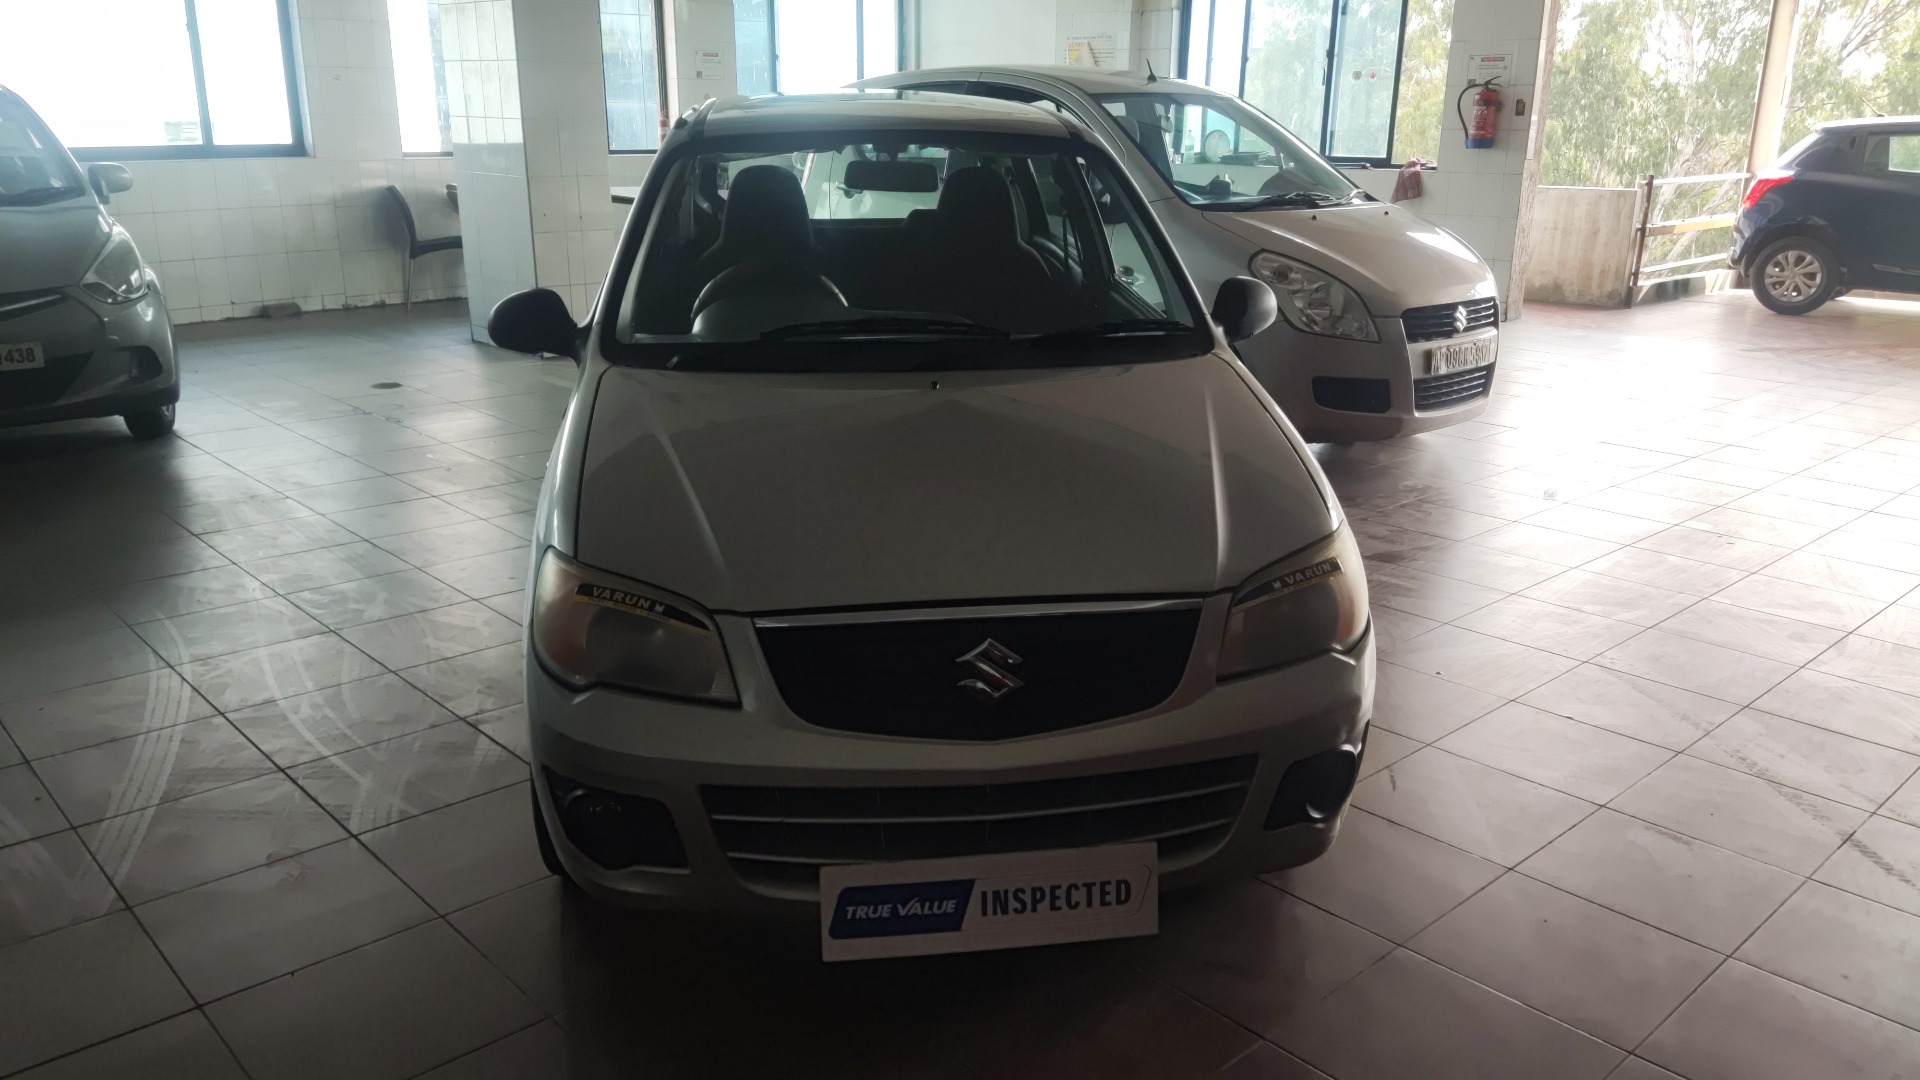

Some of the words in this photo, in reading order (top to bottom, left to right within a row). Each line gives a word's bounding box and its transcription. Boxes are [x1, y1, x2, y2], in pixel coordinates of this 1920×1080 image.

[1284, 562, 1332, 585] VARUN
[592, 586, 651, 610] VARUN
[846, 903, 891, 920] TRUE
[897, 897, 957, 918] VALUE
[981, 878, 1132, 918] INSPECTED
